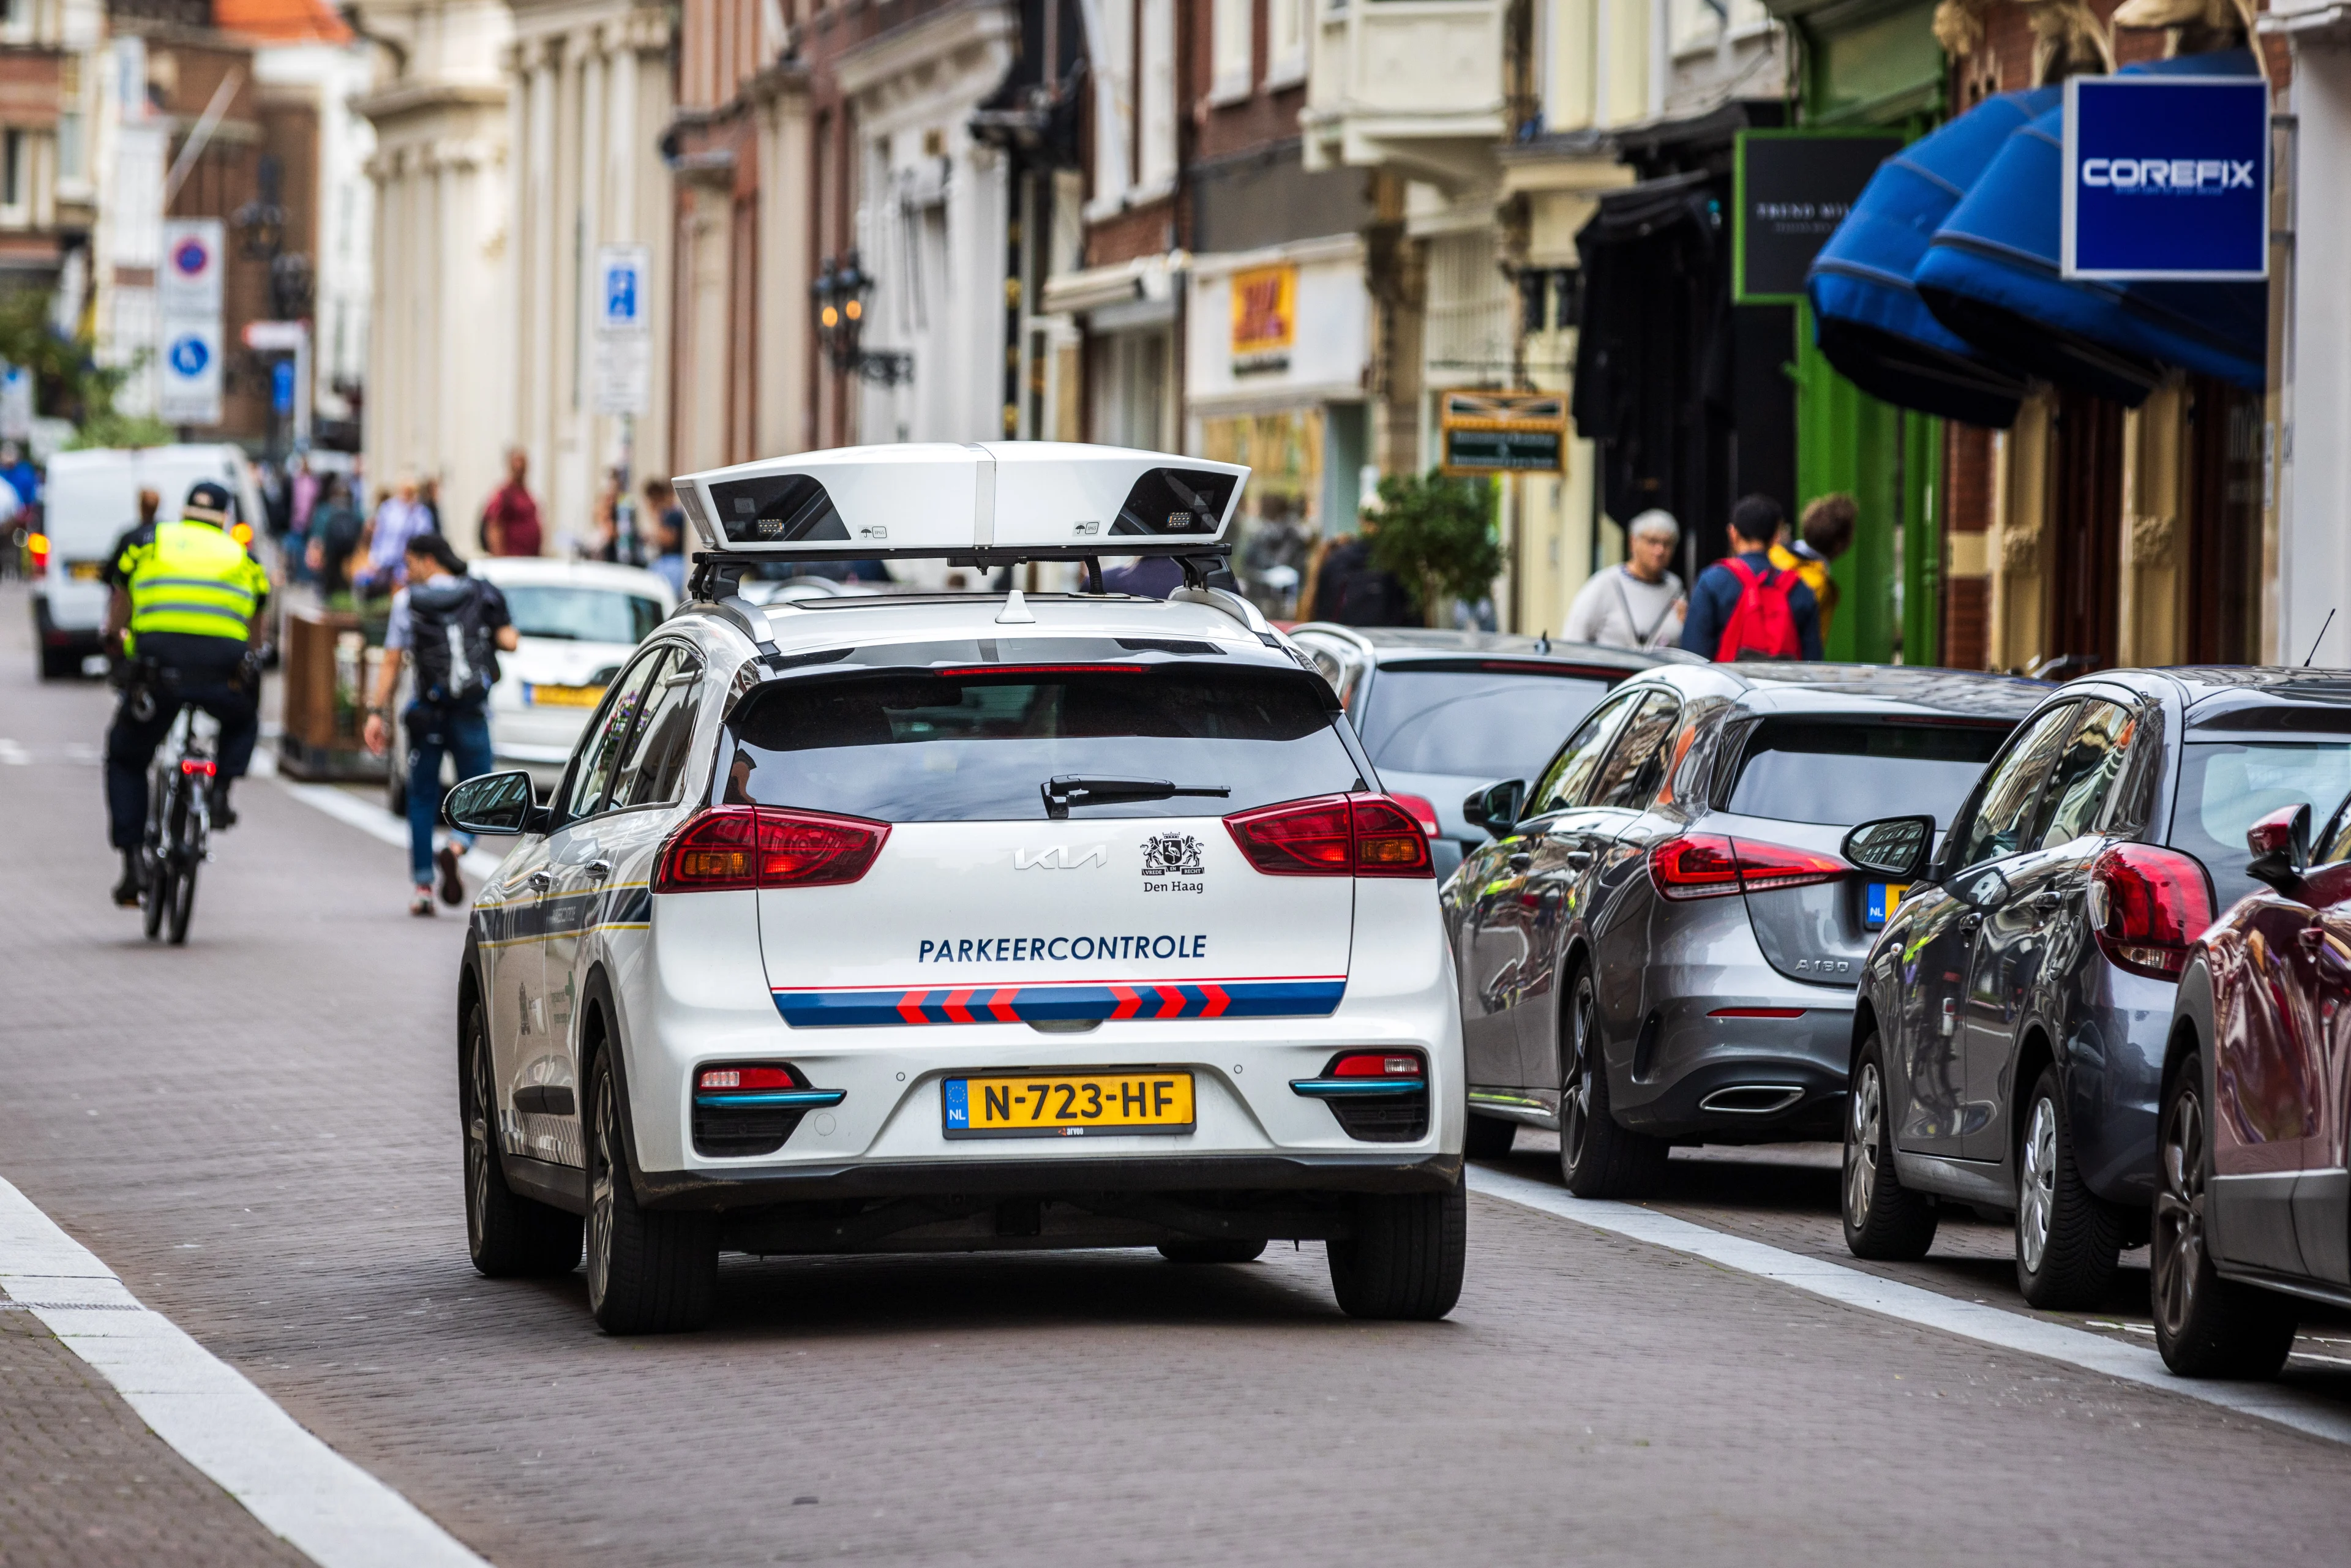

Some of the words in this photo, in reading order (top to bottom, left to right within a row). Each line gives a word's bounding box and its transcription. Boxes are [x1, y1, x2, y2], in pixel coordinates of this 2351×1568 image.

[2083, 158, 2254, 188] COREFIX
[1144, 882, 1168, 892] Den
[1171, 881, 1204, 894] Haag
[1870, 907, 1884, 917] NL
[918, 934, 1207, 963] PARKEERCONTROLE
[949, 1109, 966, 1120] NL
[984, 1081, 1174, 1122] N-723-HF
[1067, 1127, 1084, 1136] arvoo
